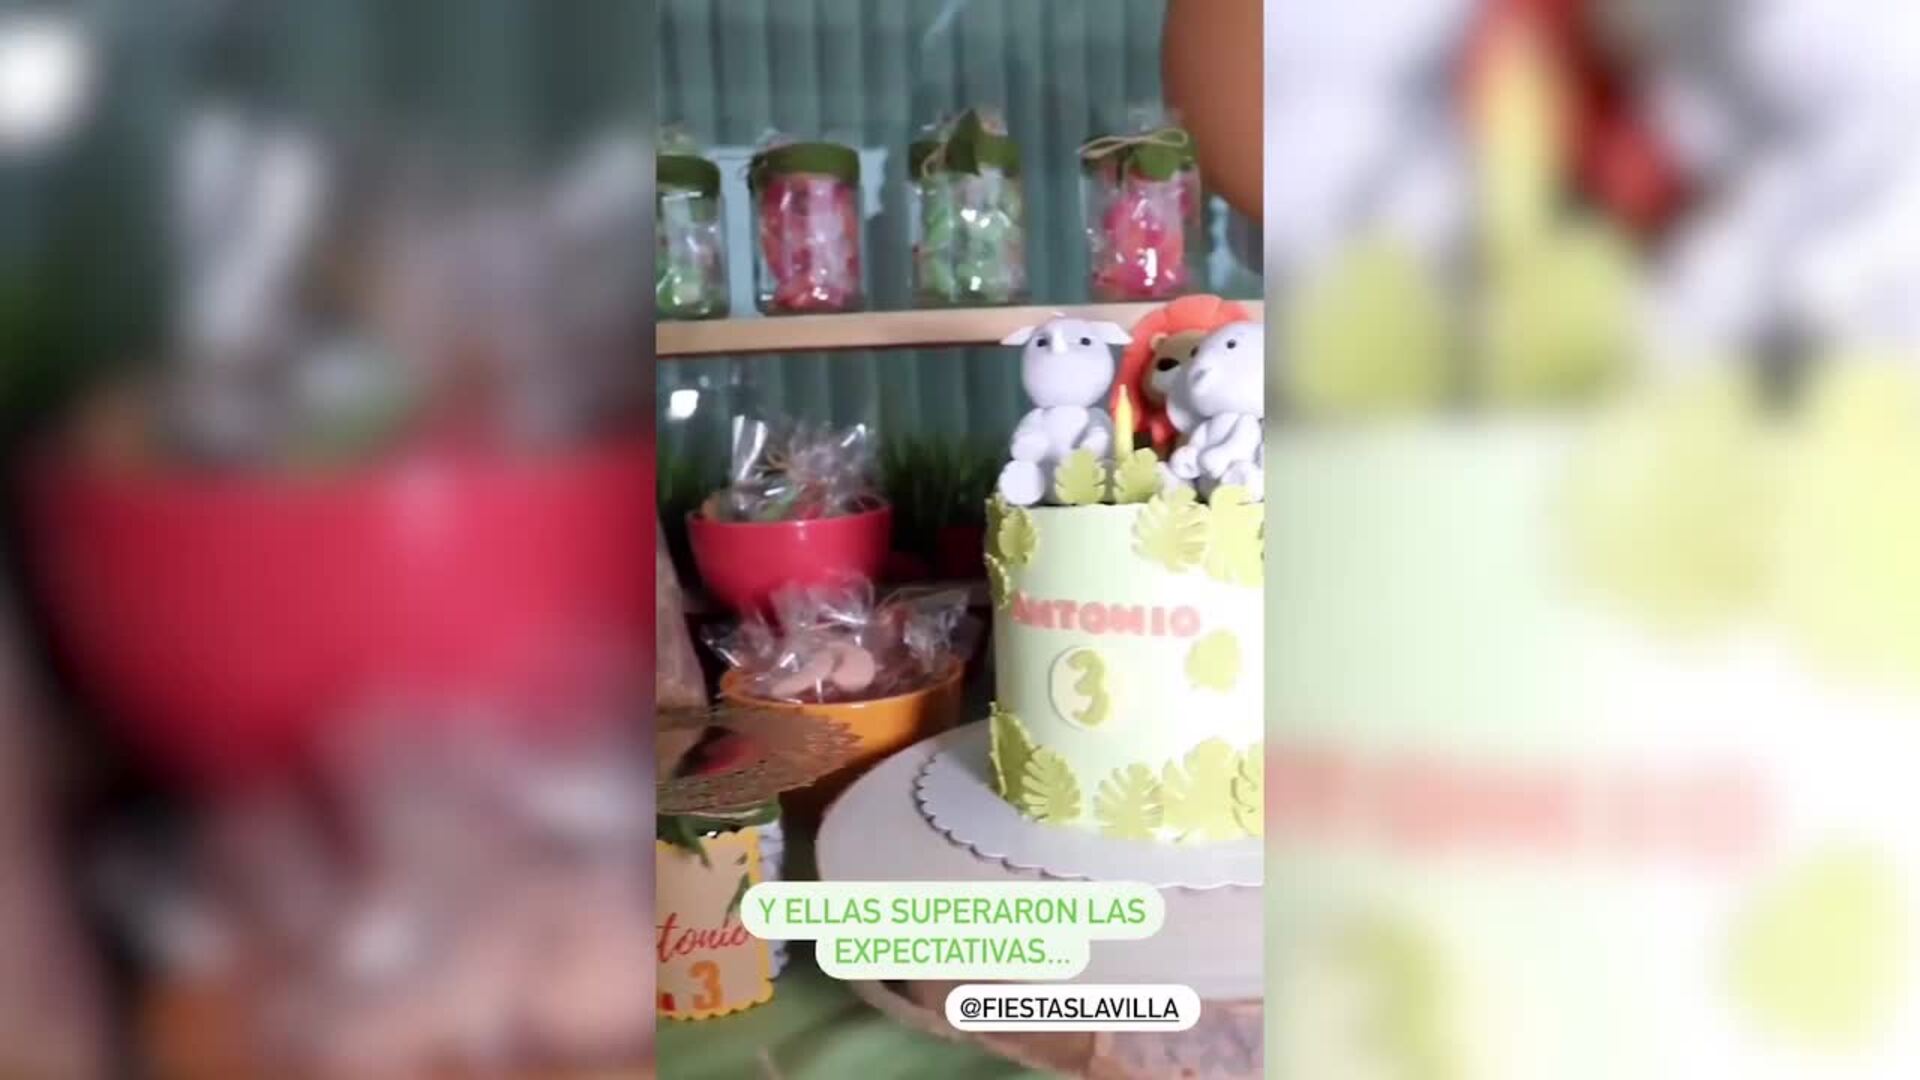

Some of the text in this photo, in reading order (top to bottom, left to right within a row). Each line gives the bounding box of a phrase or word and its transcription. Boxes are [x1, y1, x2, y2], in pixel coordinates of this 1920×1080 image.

[1012, 592, 1201, 638] ANTONIO
[1067, 649, 1109, 727] 3
[690, 960, 723, 1010] 3
